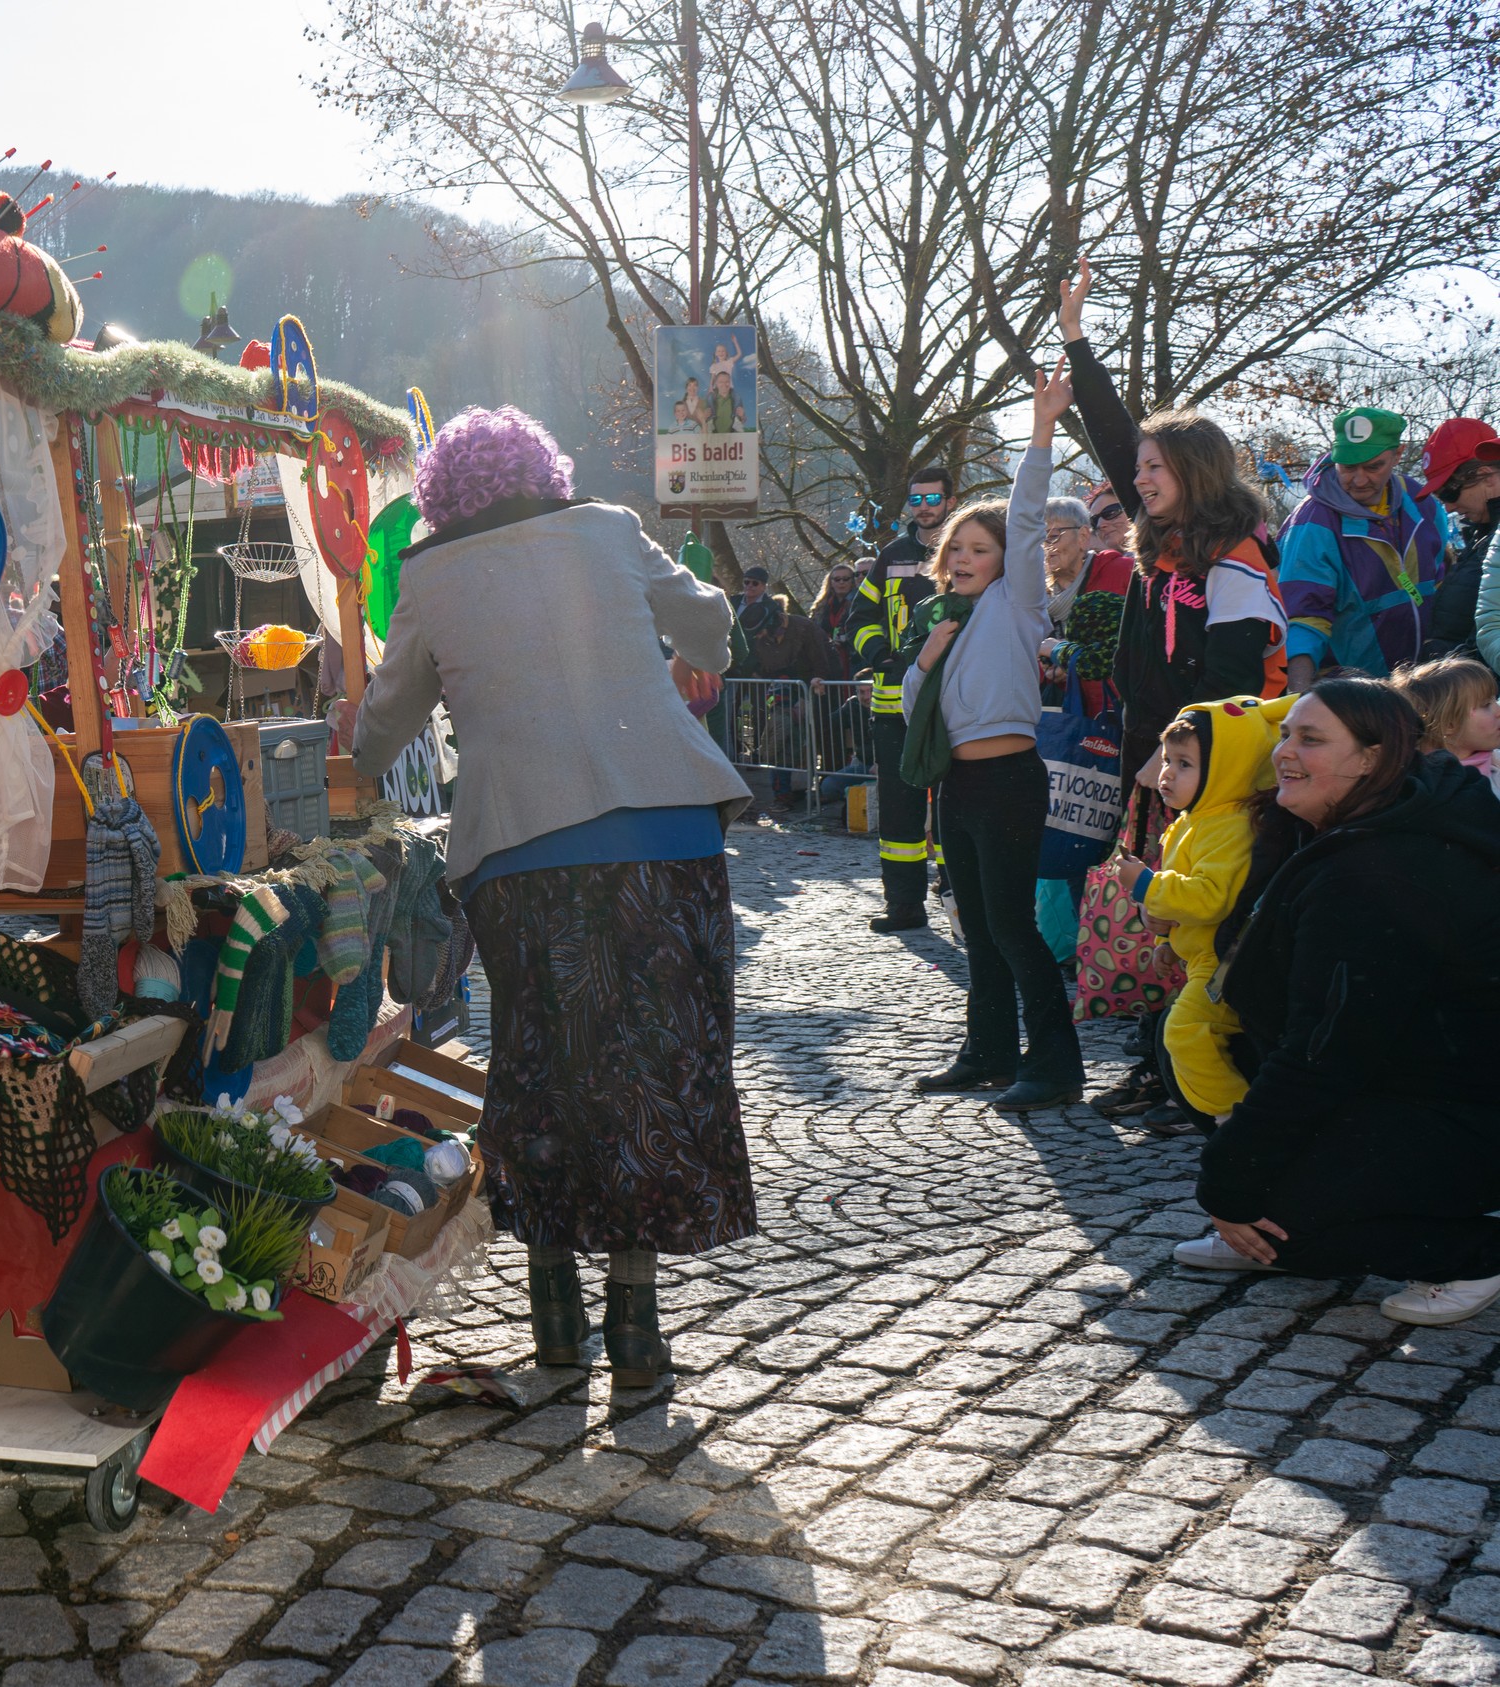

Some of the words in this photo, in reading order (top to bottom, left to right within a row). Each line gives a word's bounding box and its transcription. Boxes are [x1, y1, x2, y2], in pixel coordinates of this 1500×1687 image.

[1350, 420, 1364, 439] L
[671, 443, 696, 462] Bis
[703, 441, 743, 461] bald!
[1048, 770, 1066, 792] ET
